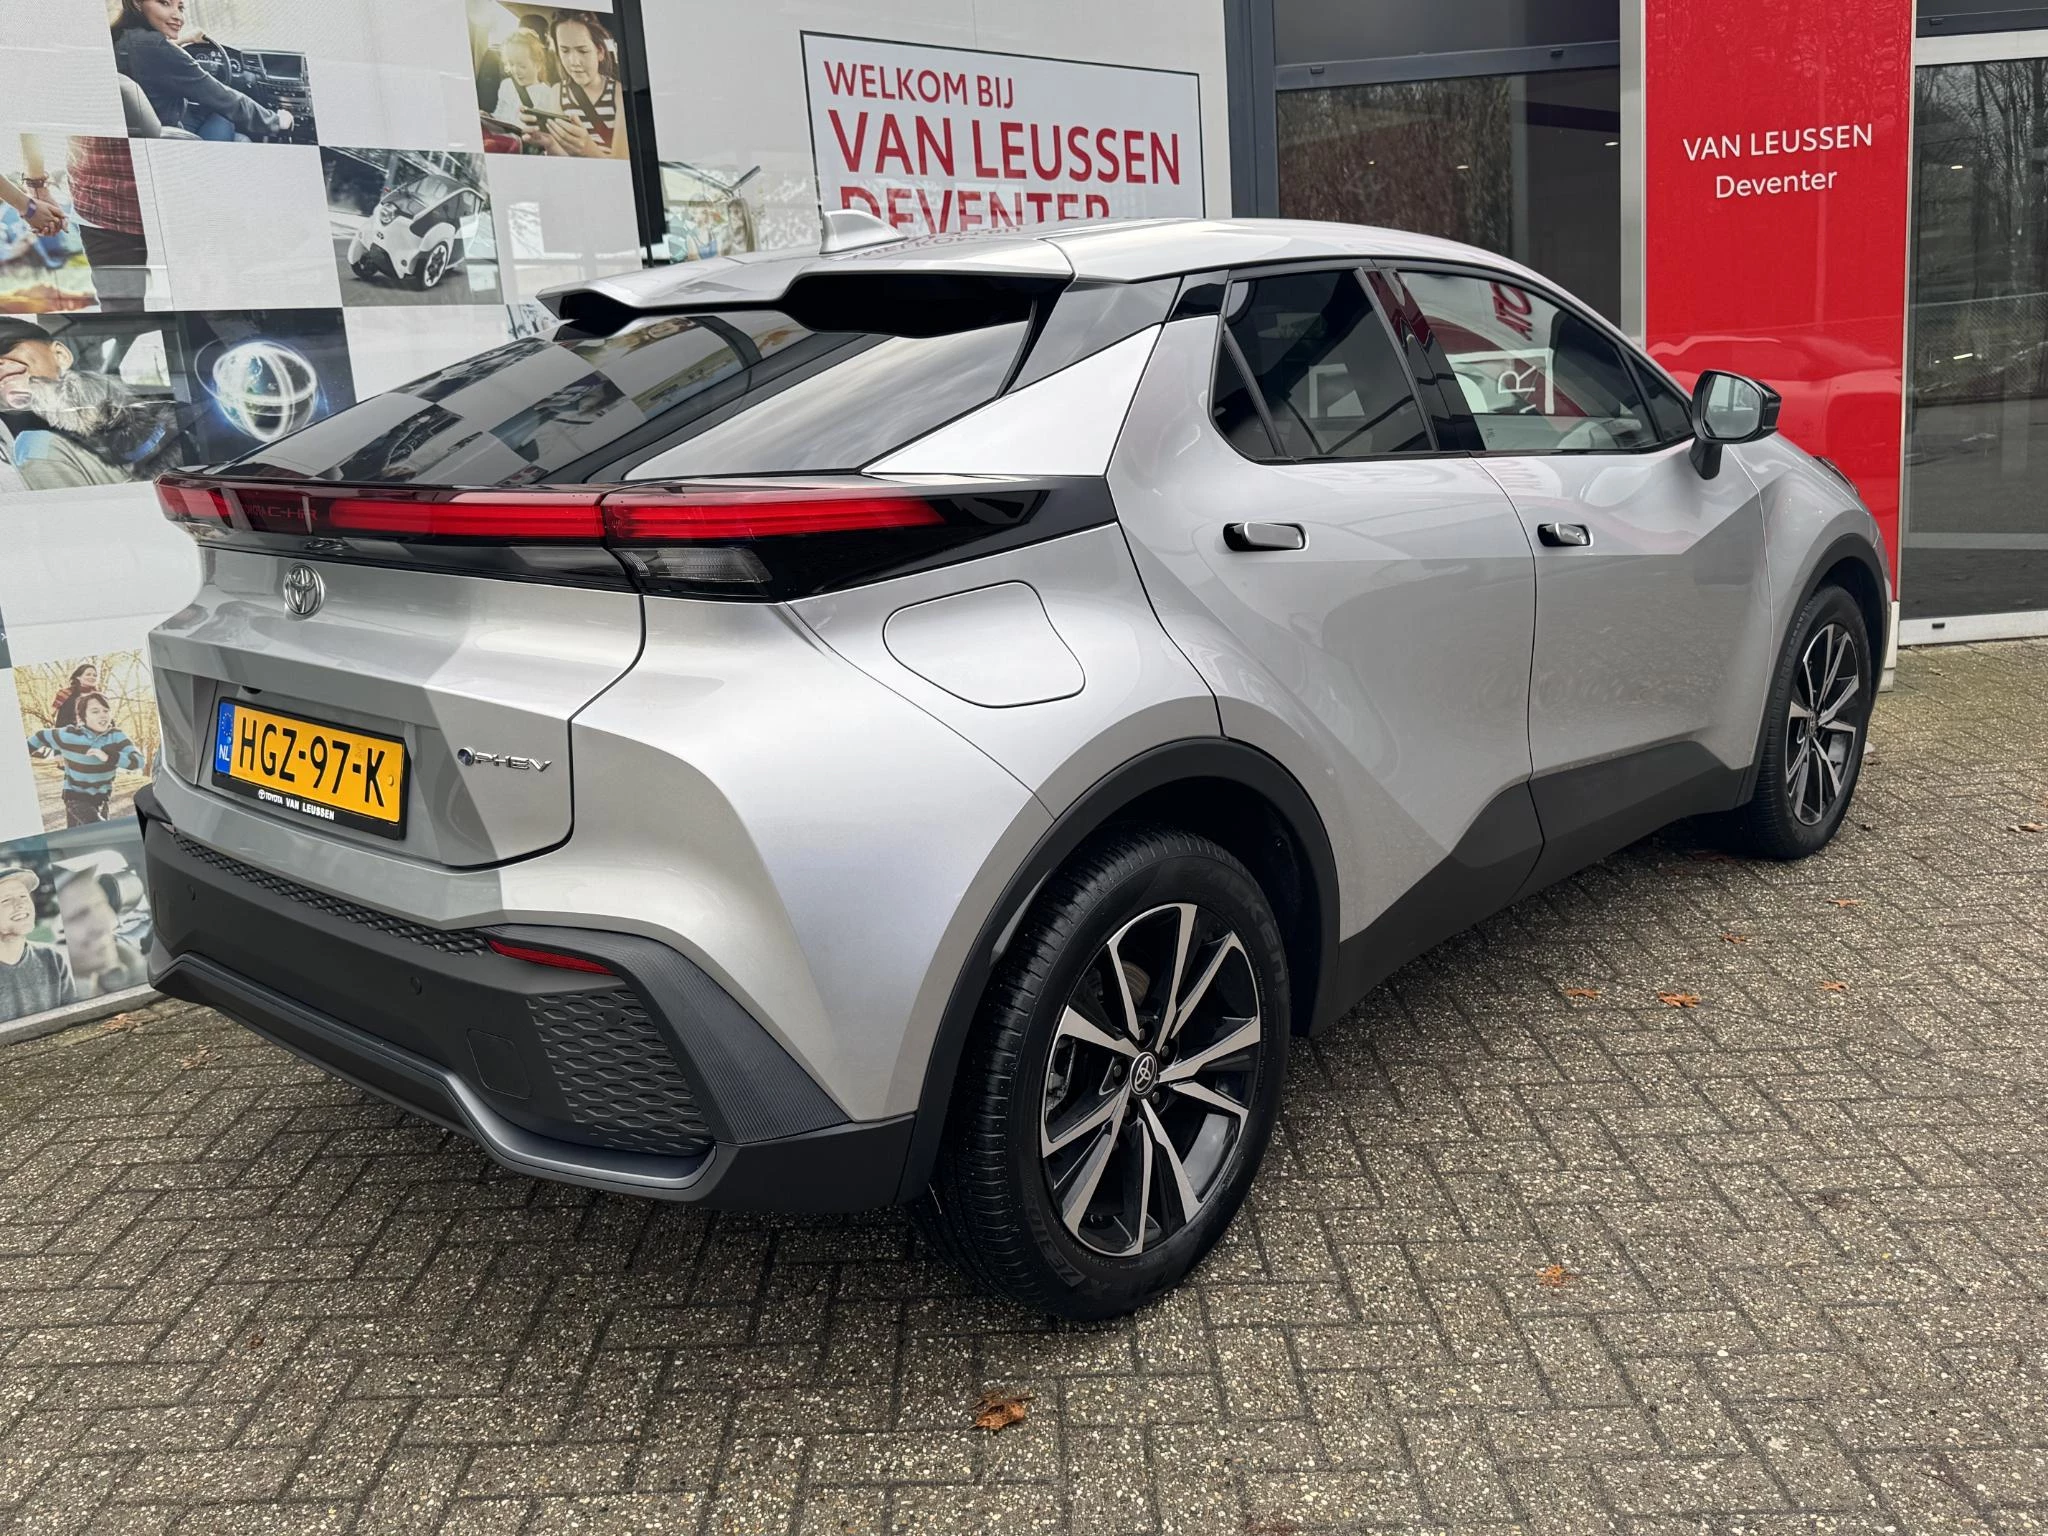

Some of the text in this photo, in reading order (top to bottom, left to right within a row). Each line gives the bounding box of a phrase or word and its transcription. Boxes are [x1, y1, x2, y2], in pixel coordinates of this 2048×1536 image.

[823, 61, 1014, 109] WELKOM BIJ
[828, 110, 1180, 185] VAN LEUSSEN
[1683, 123, 1872, 161] VAN LEUSSEN
[1716, 170, 1837, 199] Deventer
[218, 743, 231, 762] NL
[239, 717, 386, 807] HGZ-97-K
[474, 751, 552, 772] PHEV
[265, 791, 335, 821] TOYOTA VAN LEUSSEN
